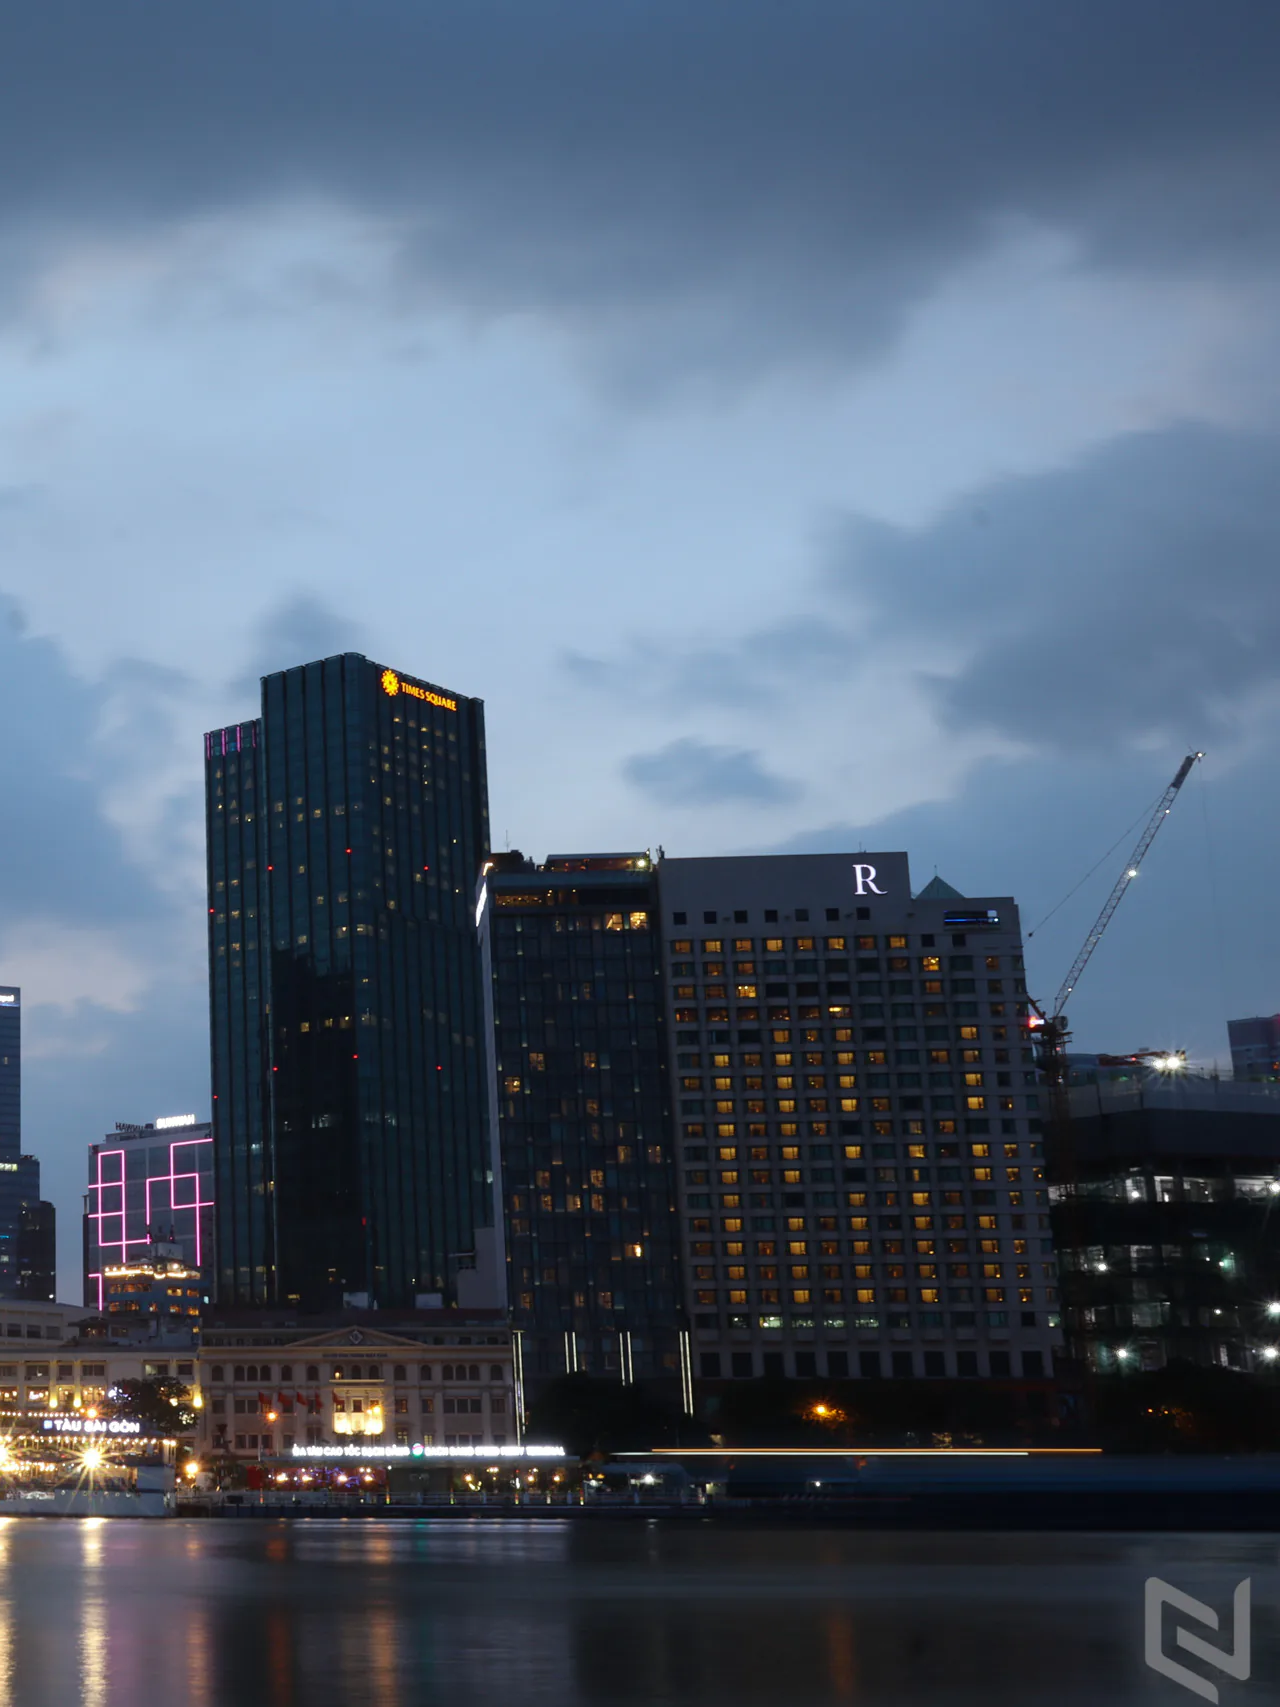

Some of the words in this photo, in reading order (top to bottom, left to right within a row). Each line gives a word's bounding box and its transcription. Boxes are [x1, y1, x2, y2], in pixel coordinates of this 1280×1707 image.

[400, 682, 425, 700] TIMES
[425, 691, 457, 711] SQUARE
[852, 864, 888, 895] R
[54, 1418, 81, 1432] TÀU
[109, 1419, 140, 1434] GÒN
